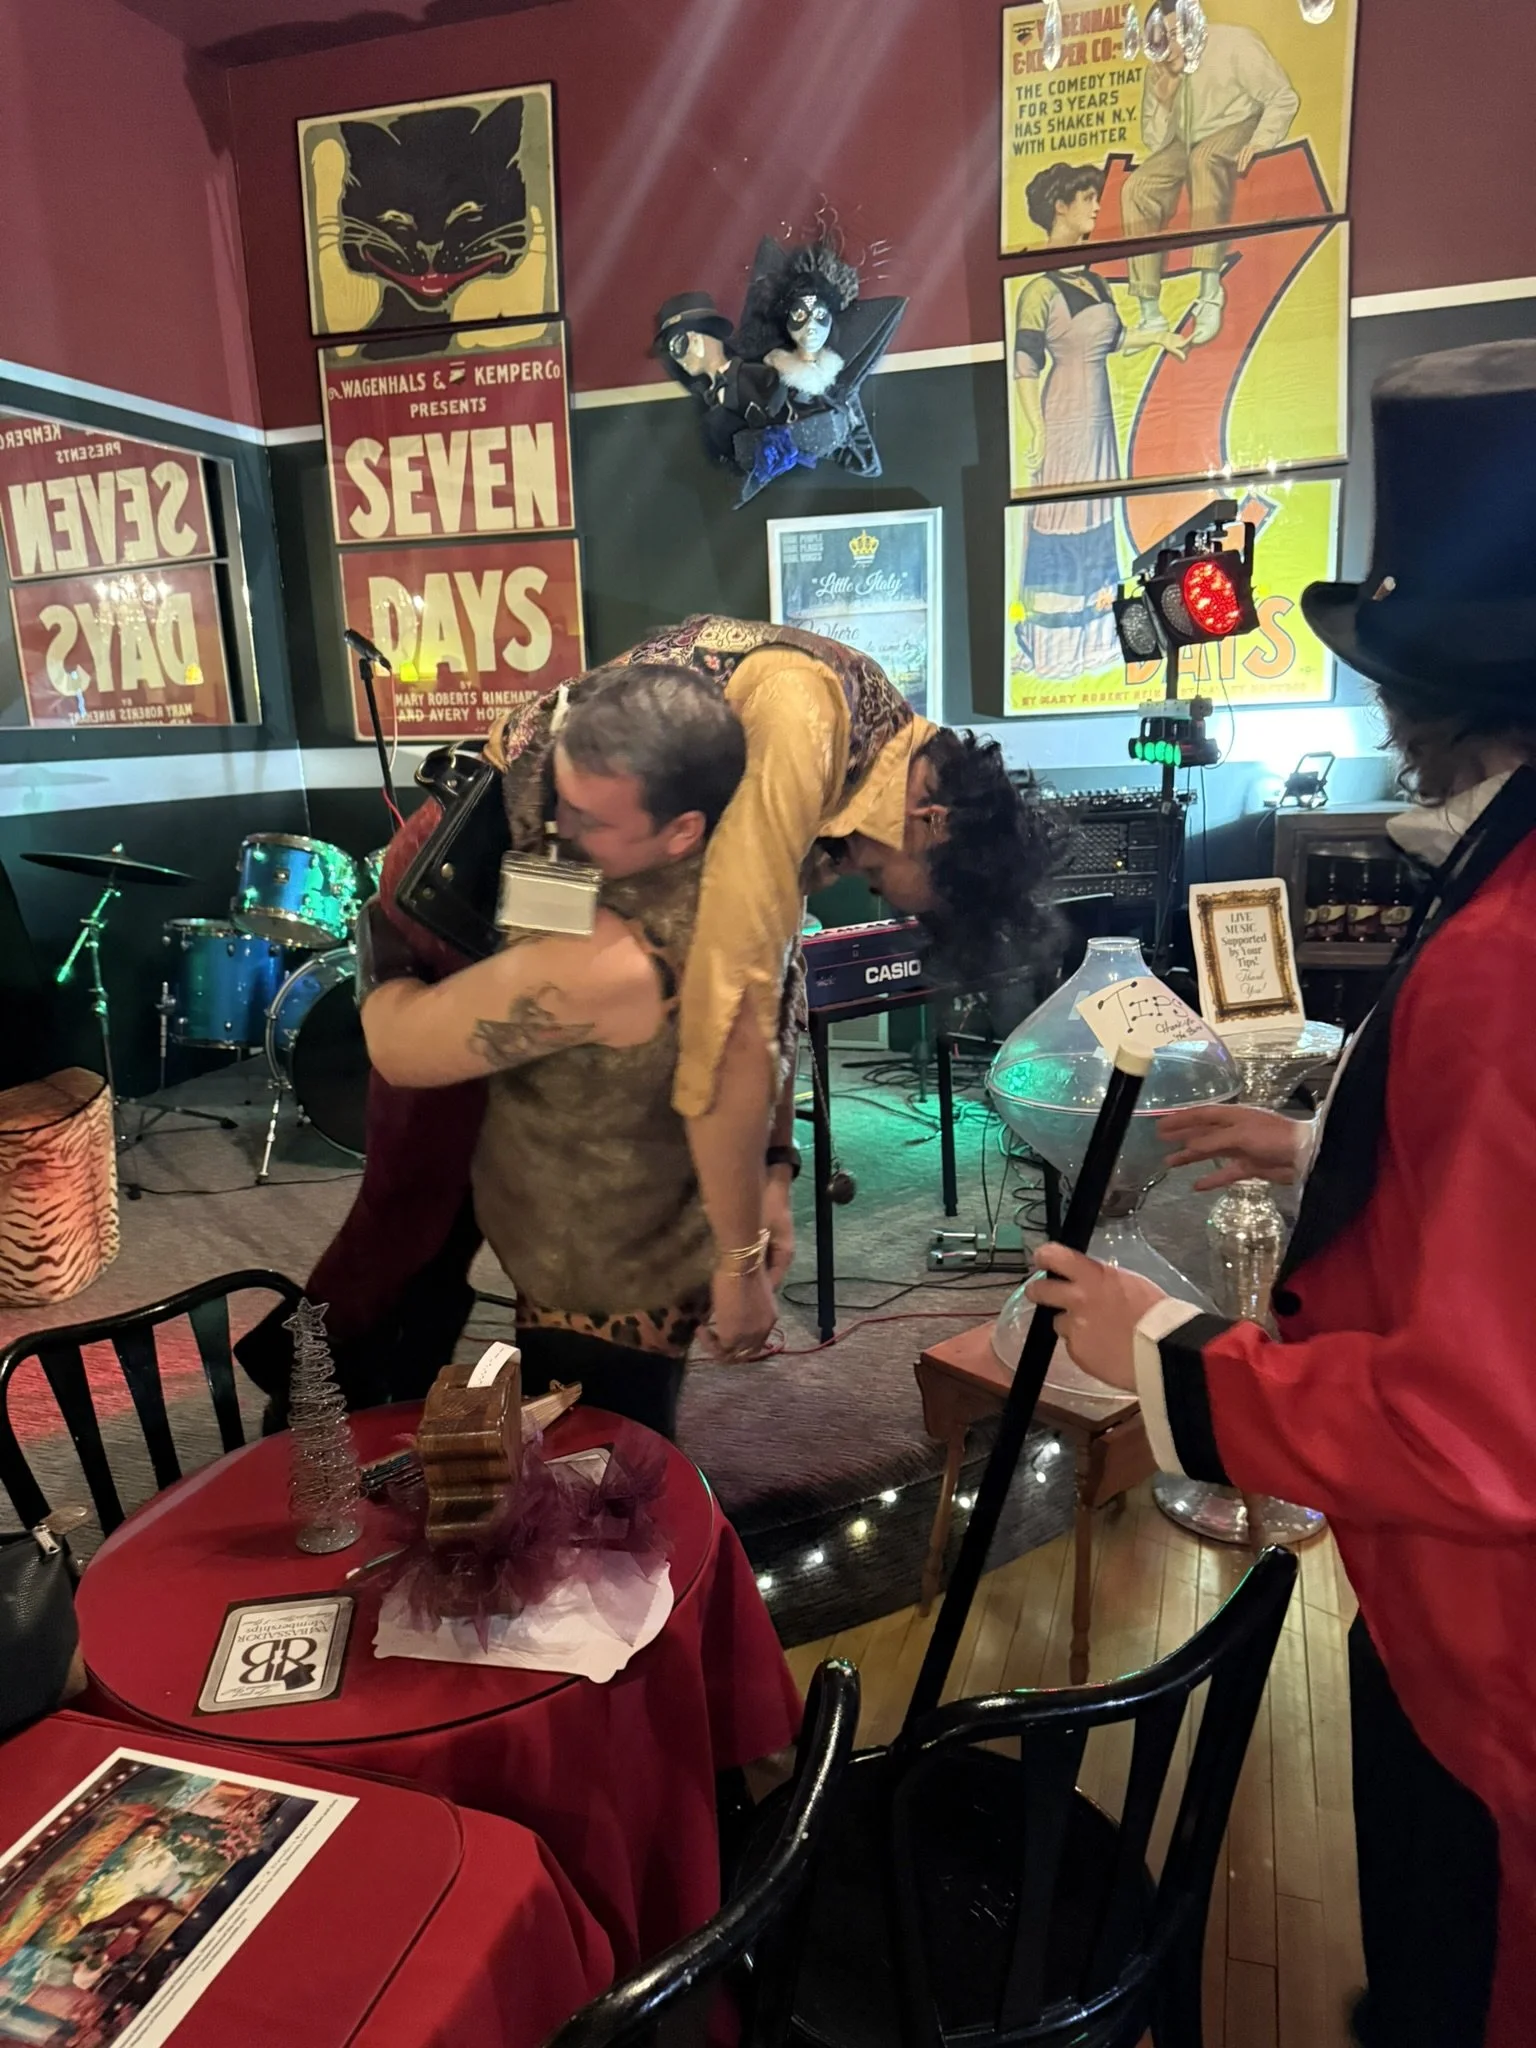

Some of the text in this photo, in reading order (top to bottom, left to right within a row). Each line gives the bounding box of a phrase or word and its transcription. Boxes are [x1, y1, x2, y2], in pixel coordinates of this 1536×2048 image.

[1016, 68, 1143, 101] THE COMEDY THAT
[1019, 90, 1119, 119] FOR 3 YEARS
[1015, 106, 1137, 138] HAS SHAKEN N.Y.
[1013, 127, 1127, 156] WITH LAUGHTER
[328, 372, 426, 400] WAGENHALS
[474, 364, 541, 386] KEMPER
[410, 397, 487, 418] PRESENTS
[344, 422, 559, 539] SEVEN
[368, 566, 552, 677] DAYS
[459, 681, 472, 690] BY
[395, 693, 424, 706] MARY
[428, 691, 477, 706] ROBERTS
[429, 708, 470, 721] AVERY
[1230, 911, 1253, 923] LIVE
[1225, 923, 1256, 934] MUSIC
[1221, 932, 1267, 947] Supported
[1229, 946, 1262, 958] by Your
[866, 960, 922, 984] CASIO
[237, 1625, 328, 1643] AMBASSADOR
[246, 1619, 325, 1634] Memberships
